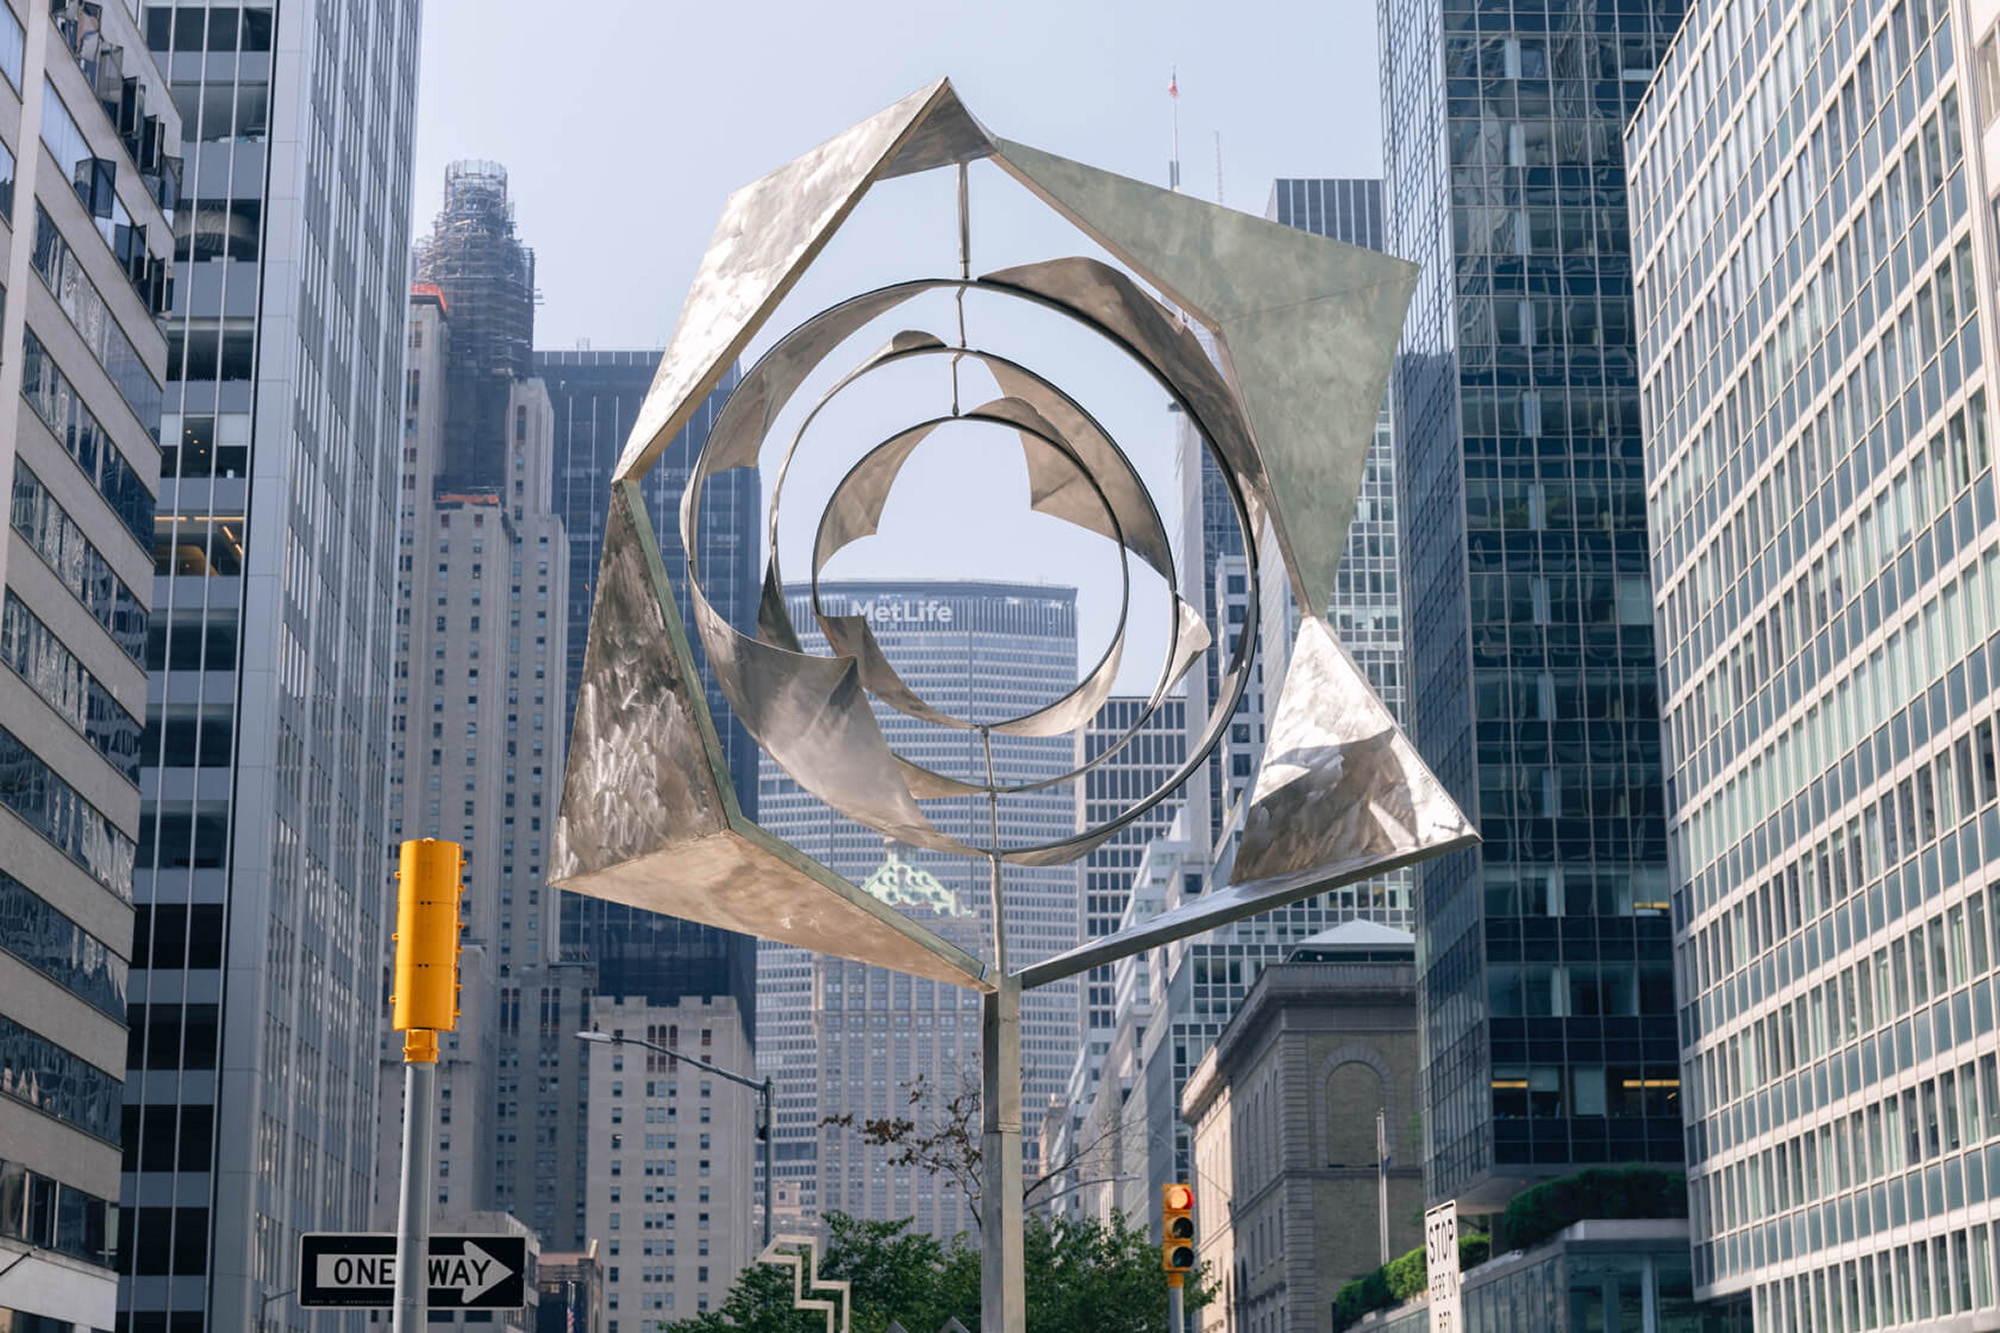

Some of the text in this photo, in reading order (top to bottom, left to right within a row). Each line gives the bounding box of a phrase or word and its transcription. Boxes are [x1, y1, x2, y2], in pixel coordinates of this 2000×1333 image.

[851, 600, 953, 622] MetLife
[1428, 1218, 1454, 1265] STOP
[334, 1258, 491, 1286] ONE WAY
